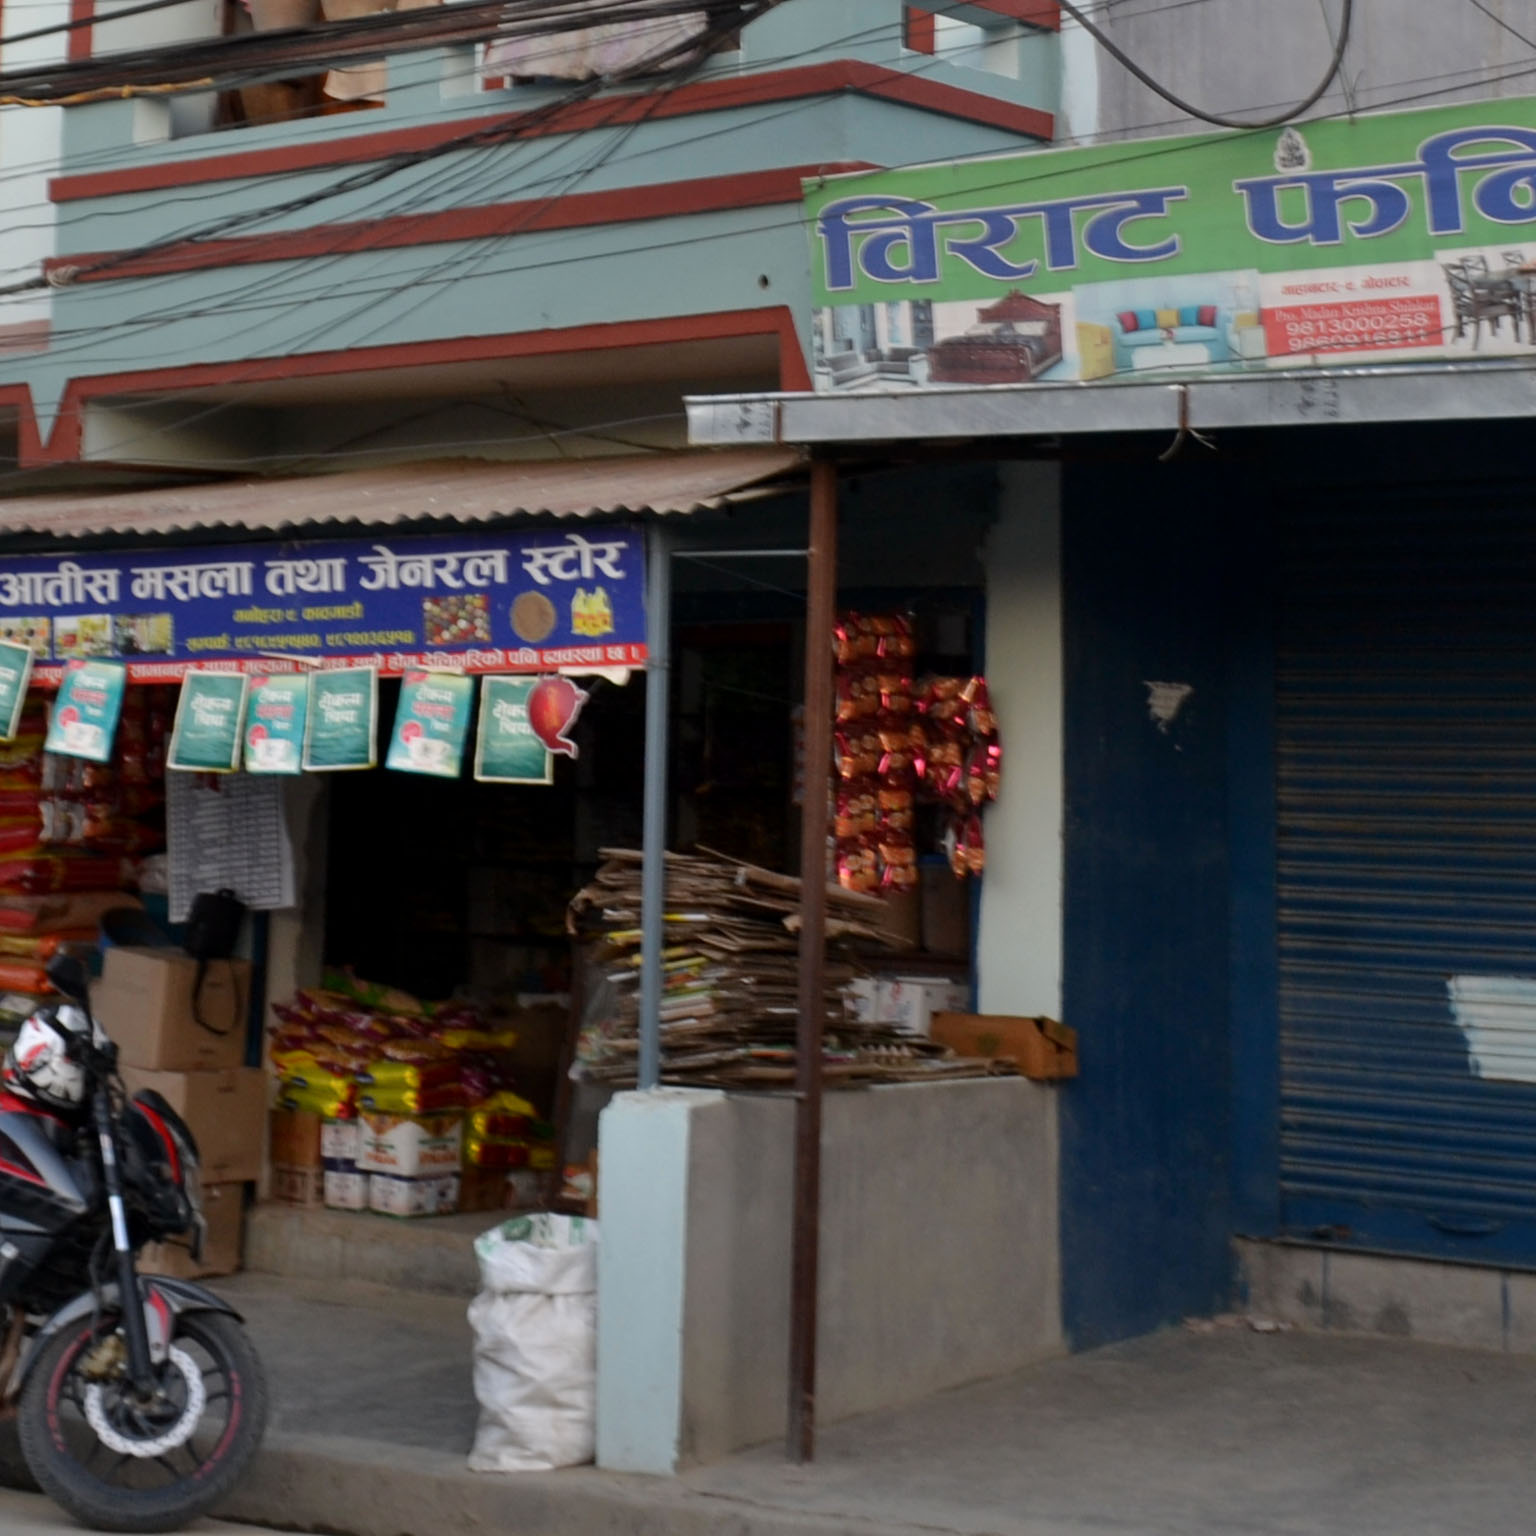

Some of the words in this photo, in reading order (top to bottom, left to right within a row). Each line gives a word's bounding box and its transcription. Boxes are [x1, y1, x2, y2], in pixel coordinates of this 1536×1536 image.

[815, 191, 1190, 292] विराट
[1285, 312, 1430, 337] 9813000258
[131, 562, 256, 602] मसला
[265, 556, 348, 596] तथा
[358, 545, 510, 590] जेनरल
[521, 534, 628, 585] स्टोर
[508, 646, 539, 664] पनि
